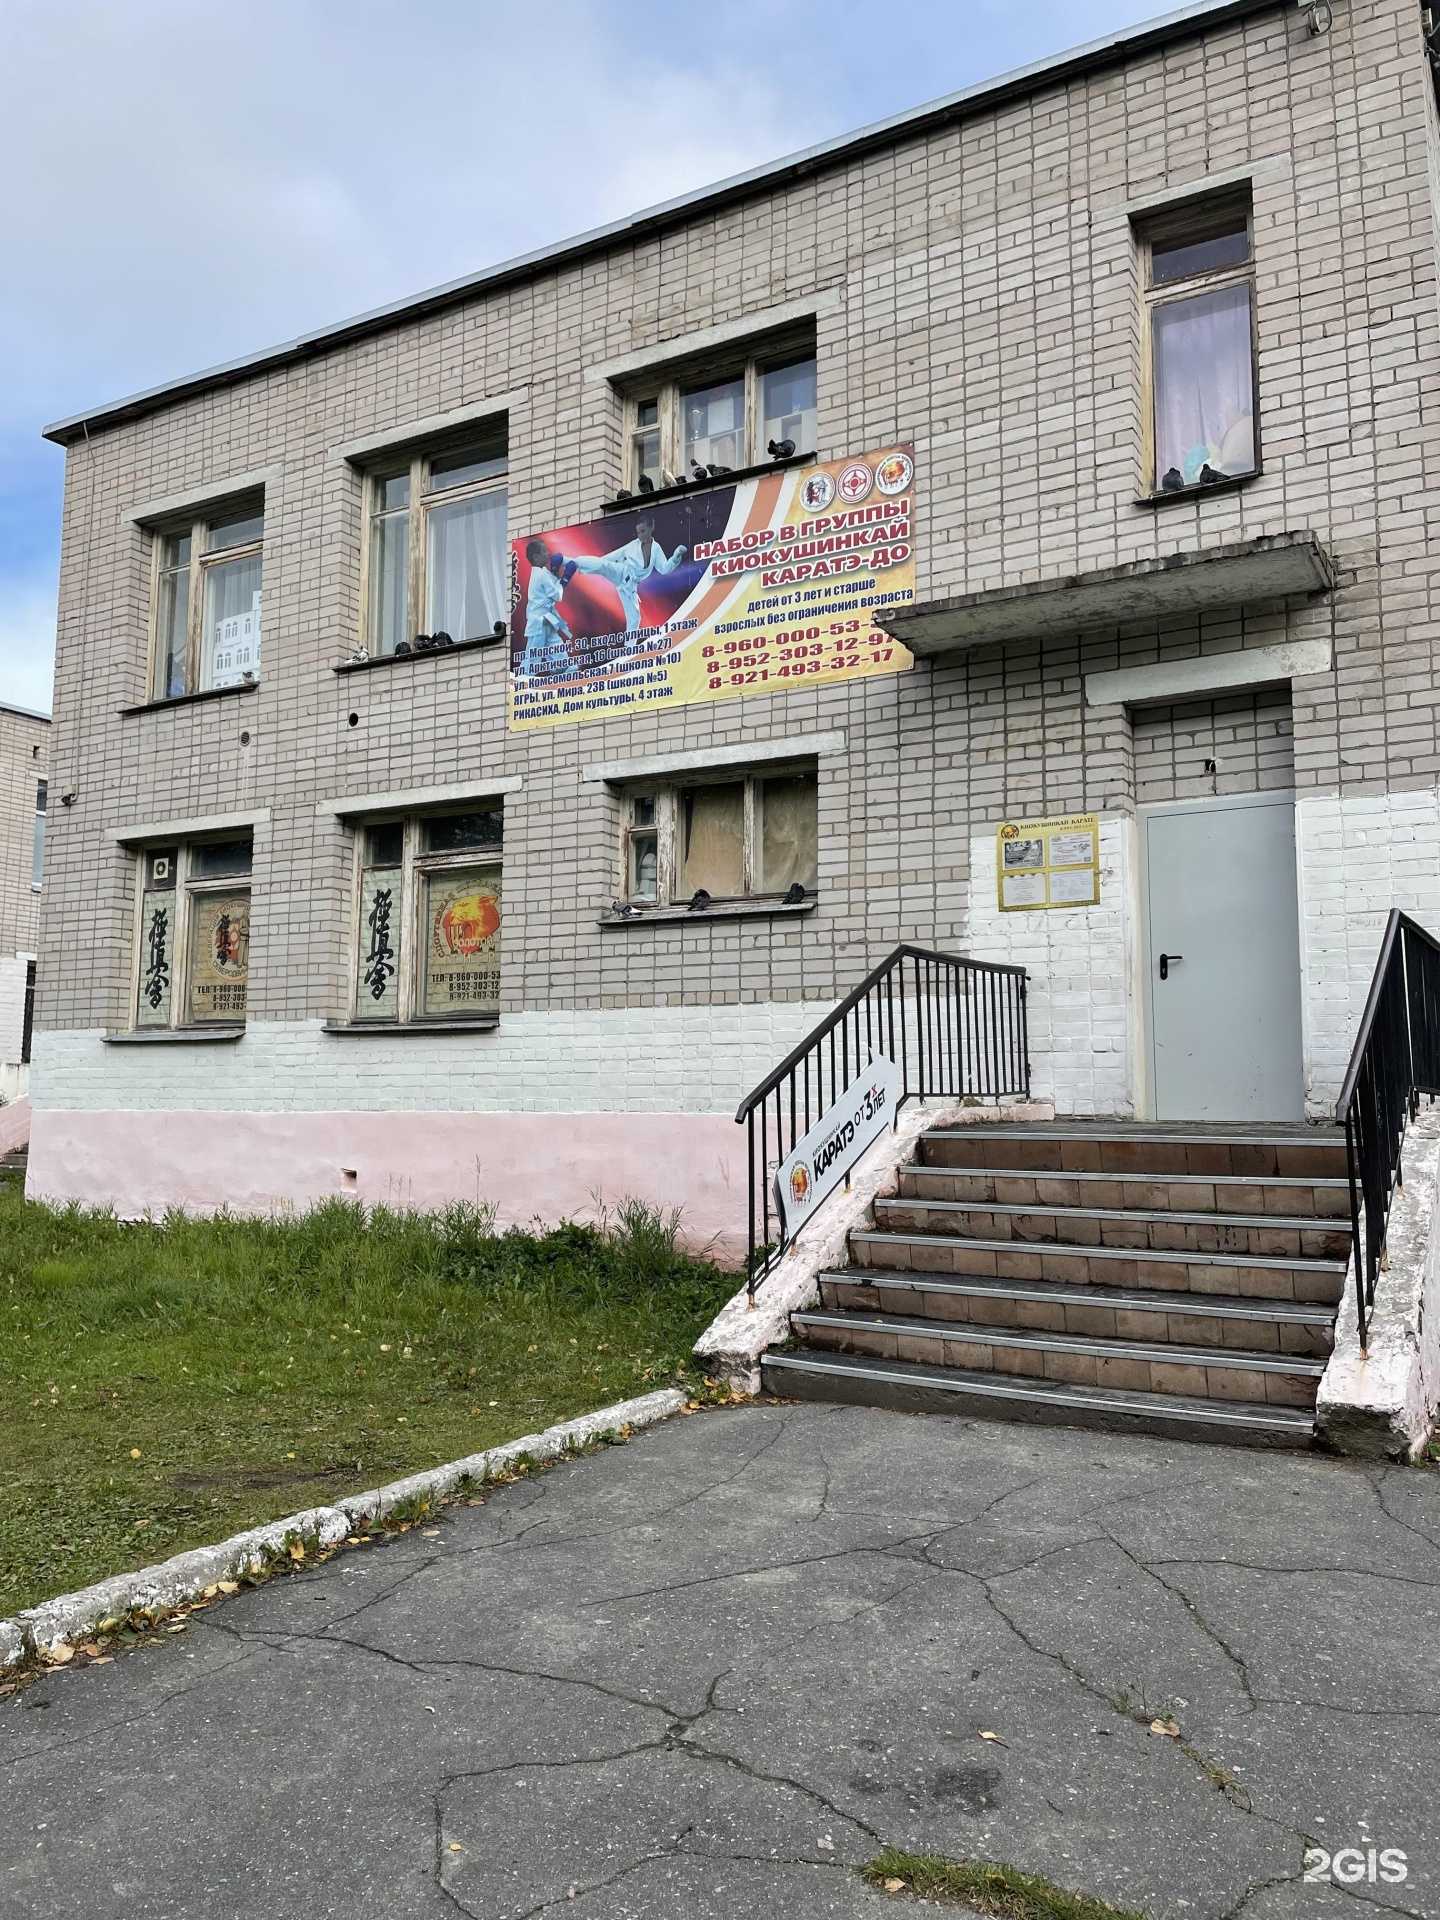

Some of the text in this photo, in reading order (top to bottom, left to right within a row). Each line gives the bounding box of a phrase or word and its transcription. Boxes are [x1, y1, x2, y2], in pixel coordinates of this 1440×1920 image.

[695, 500, 909, 559] НАБОР В ГРУППЫ
[711, 518, 909, 576] КИОКУШИНКАЙ
[762, 545, 909, 586] КАРАТЭ-ДО
[715, 589, 913, 634] взрослых без ограничения возраста
[748, 578, 875, 613] детей от 3 лет и старше
[664, 623, 668, 633] 1
[671, 619, 698, 632] этаж
[702, 619, 879, 658] 8-960-000-53-
[607, 643, 644, 661] (школа
[647, 638, 672, 652] №27)
[616, 658, 653, 673] (школа
[656, 652, 681, 666] №10)
[709, 648, 893, 689] 8-921-493-32-17
[607, 675, 644, 690] (школа
[647, 670, 668, 683] №5)
[563, 701, 583, 714] Дом
[639, 690, 644, 700] 4
[646, 687, 673, 699] этаж
[813, 1120, 855, 1182] КАРАТЭ
[854, 1105, 864, 1127] ОТ
[873, 1088, 885, 1115] ЛЕТ
